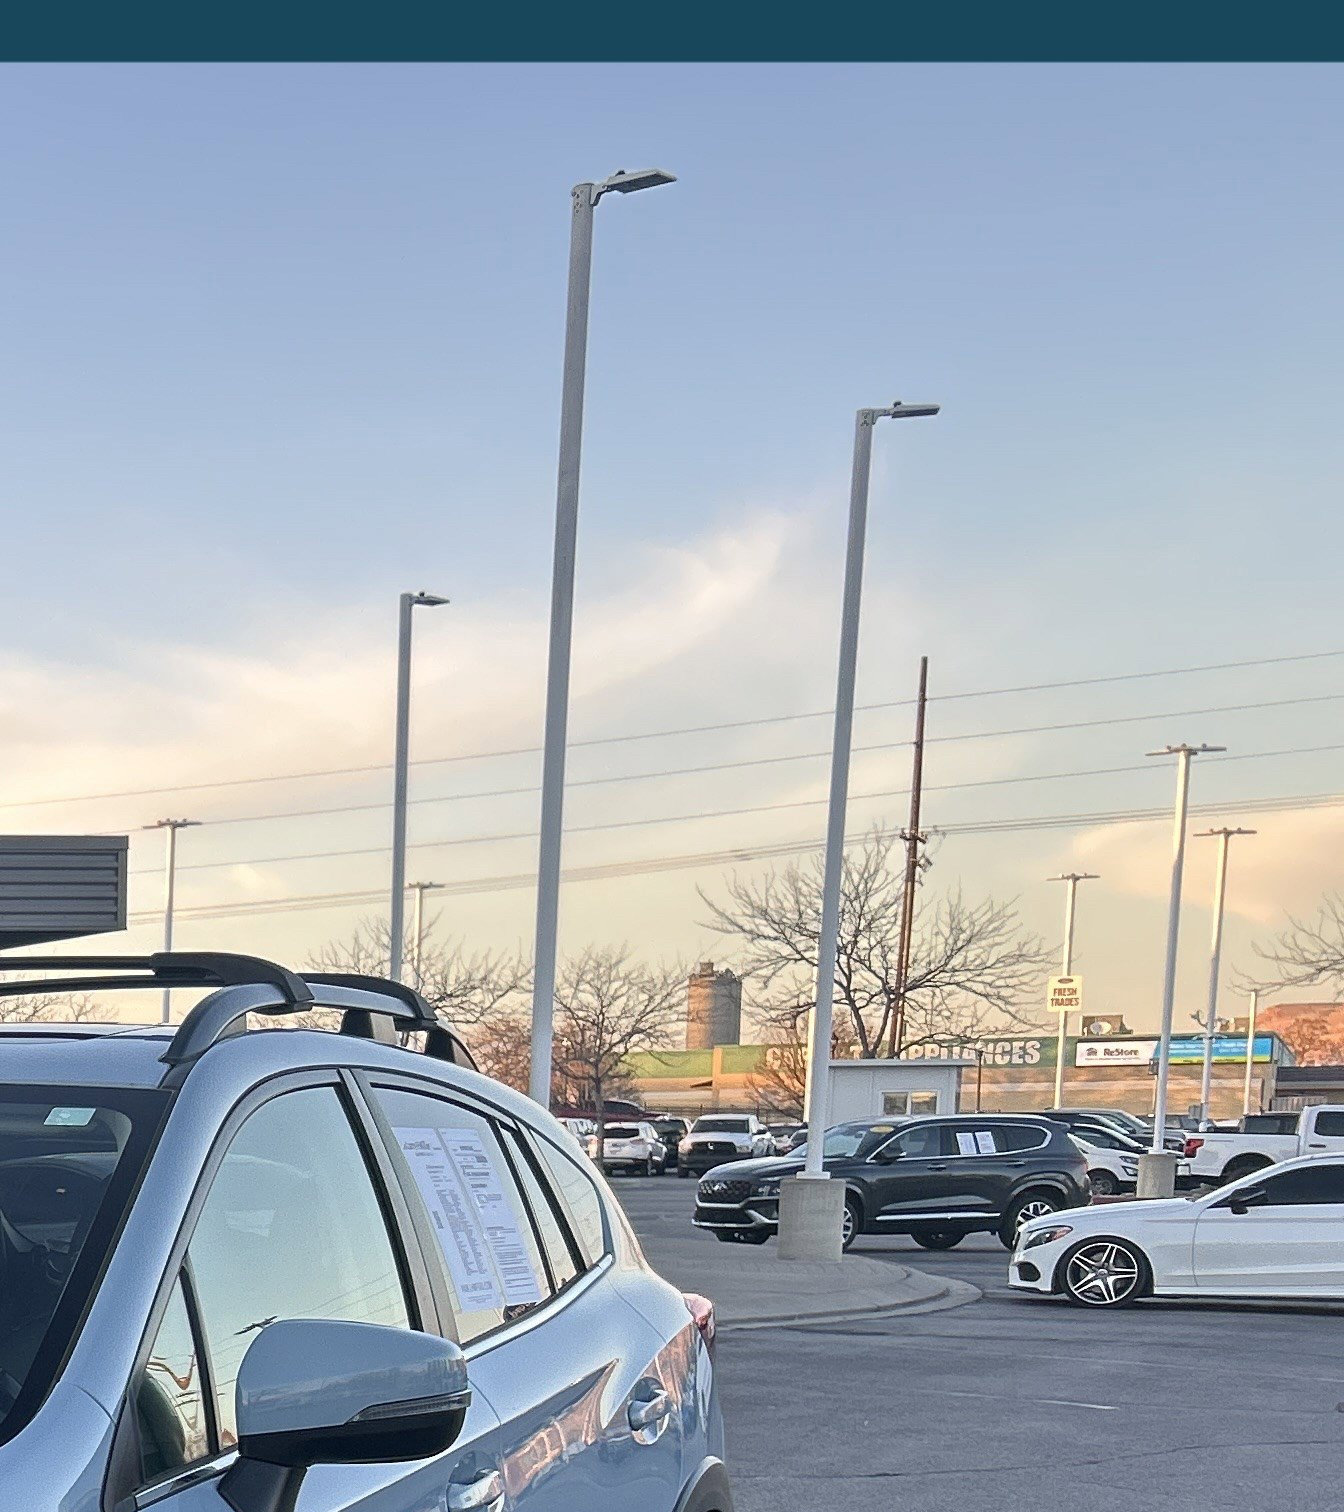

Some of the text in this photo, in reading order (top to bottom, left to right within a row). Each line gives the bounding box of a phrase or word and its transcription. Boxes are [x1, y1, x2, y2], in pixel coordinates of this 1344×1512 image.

[1053, 987, 1077, 997] FRESH
[1050, 997, 1079, 1007] TRADES
[1103, 1048, 1139, 1056] ReStore
